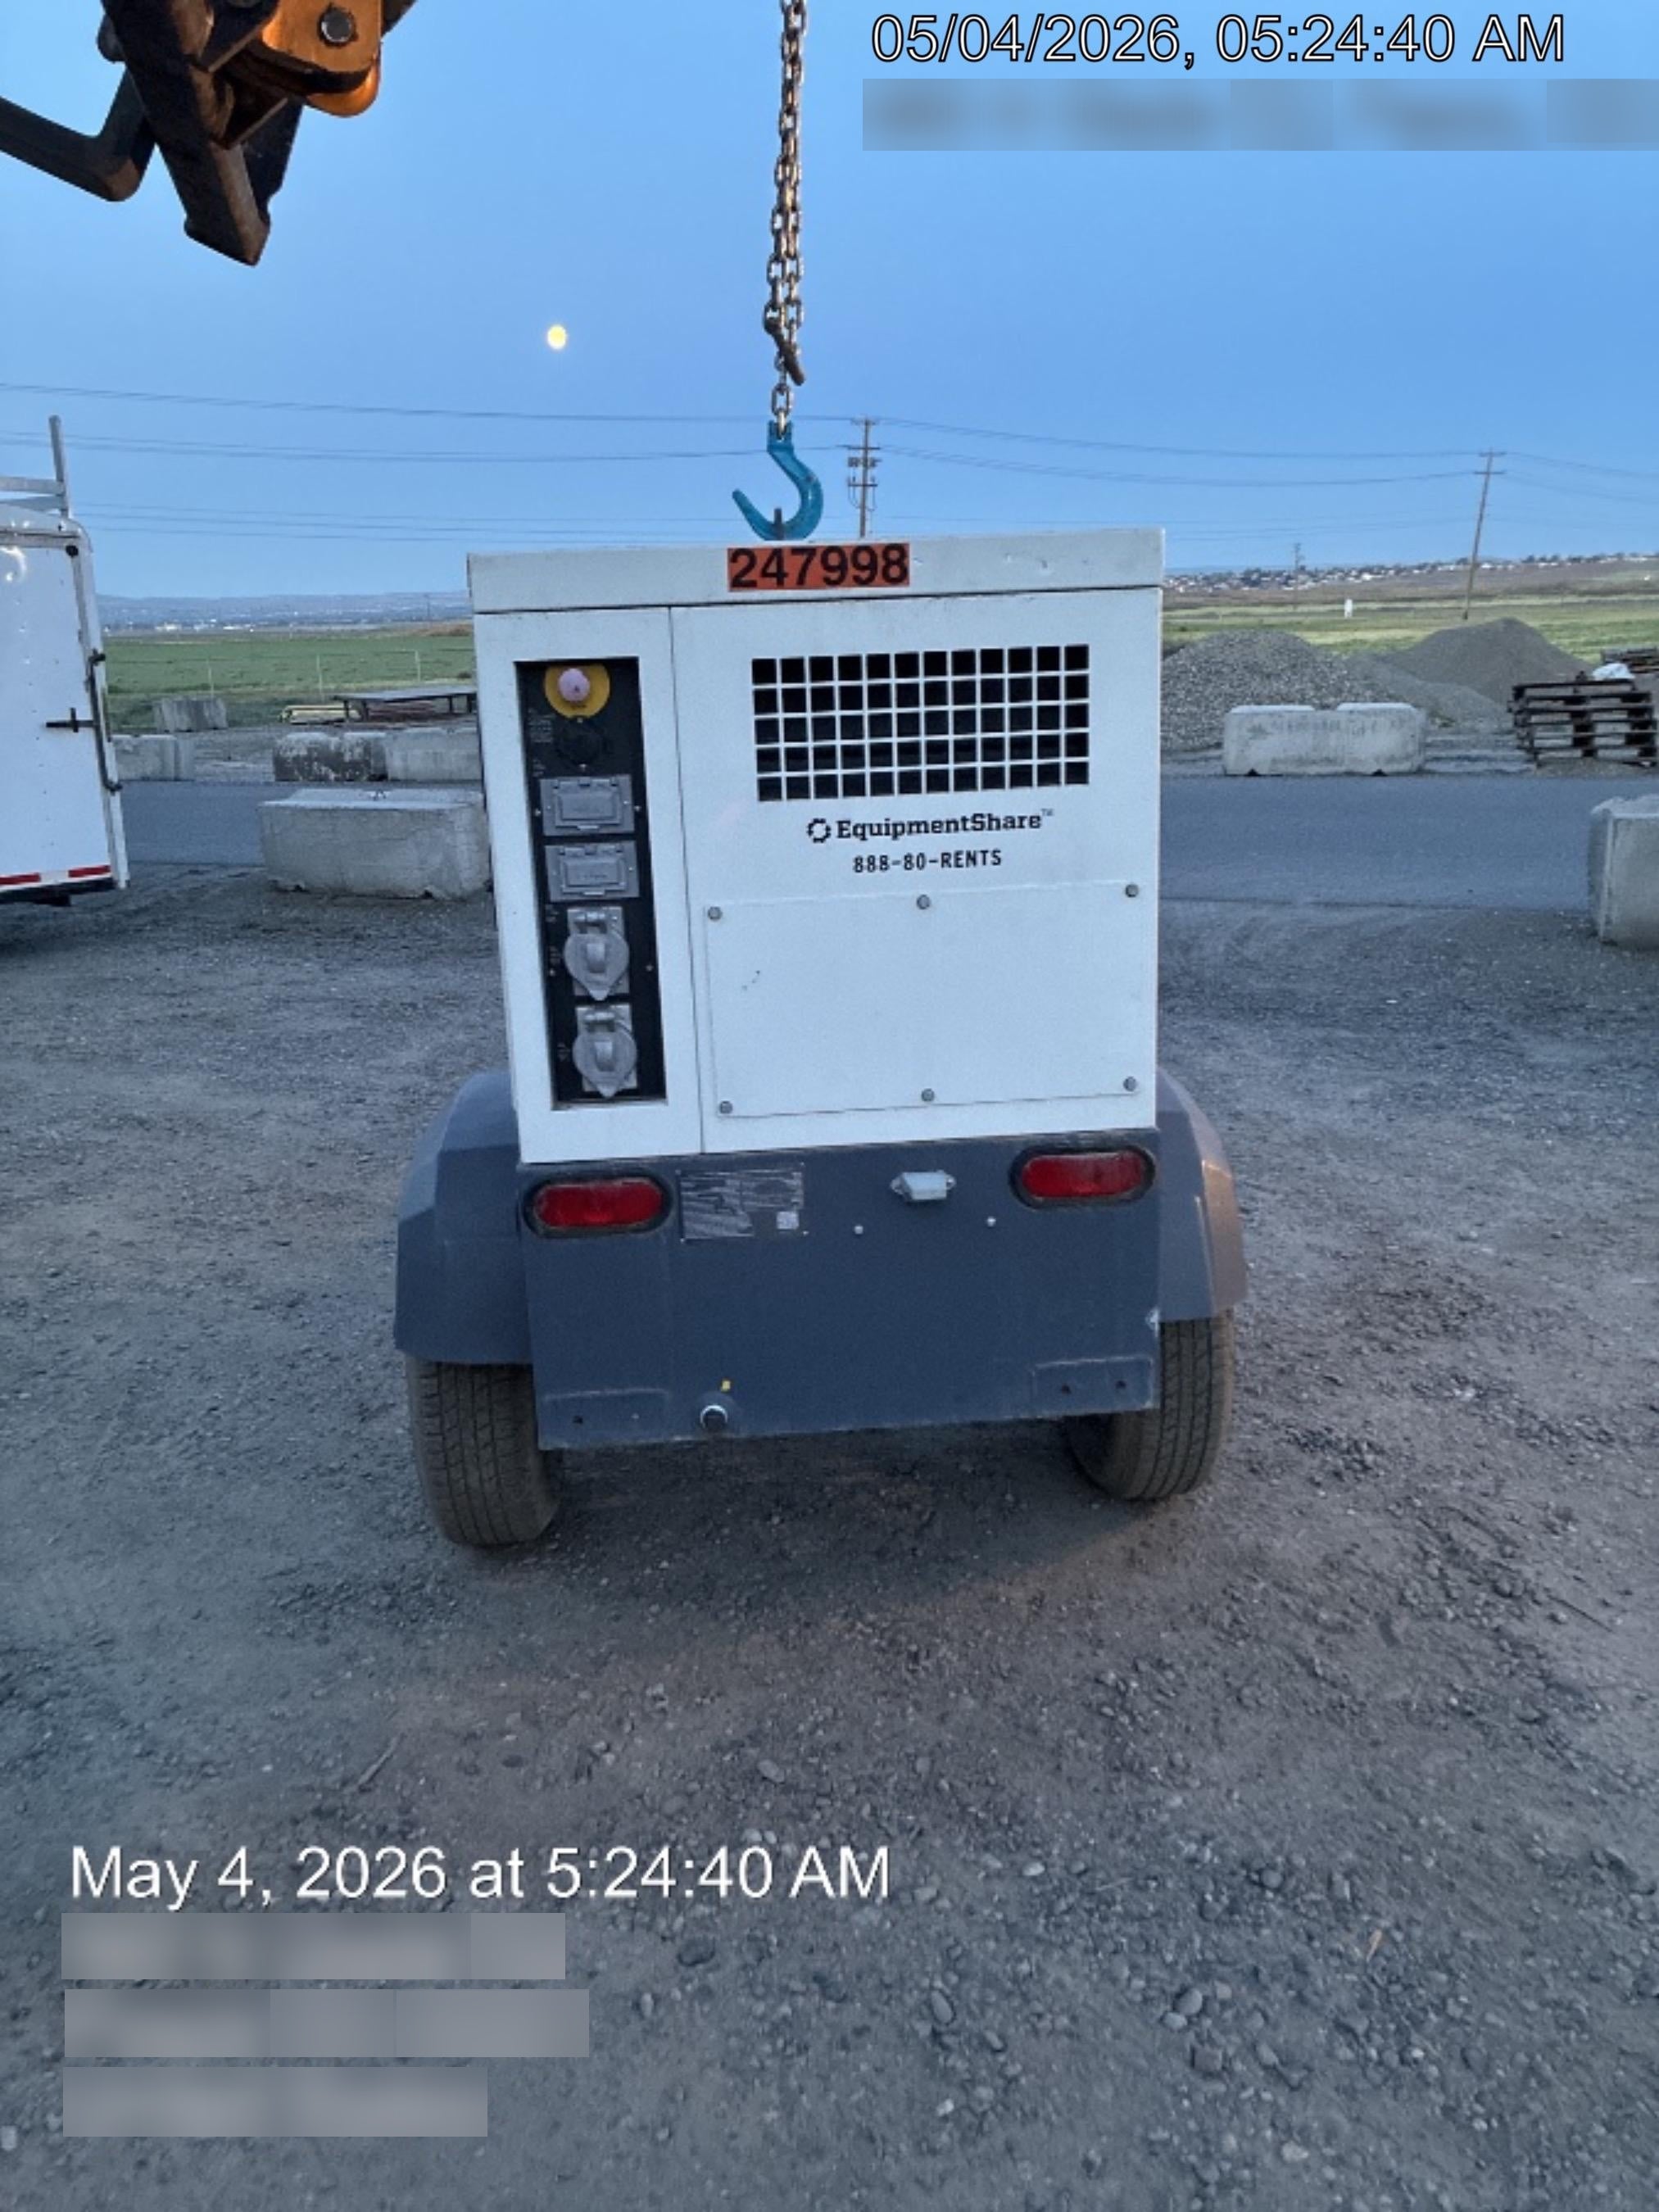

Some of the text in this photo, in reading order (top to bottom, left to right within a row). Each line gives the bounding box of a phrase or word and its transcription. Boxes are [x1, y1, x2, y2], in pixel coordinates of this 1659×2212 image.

[730, 543, 908, 587] 247998
[836, 813, 1041, 841] EquipmentShare
[853, 849, 1001, 873] 888-80-RENTS
